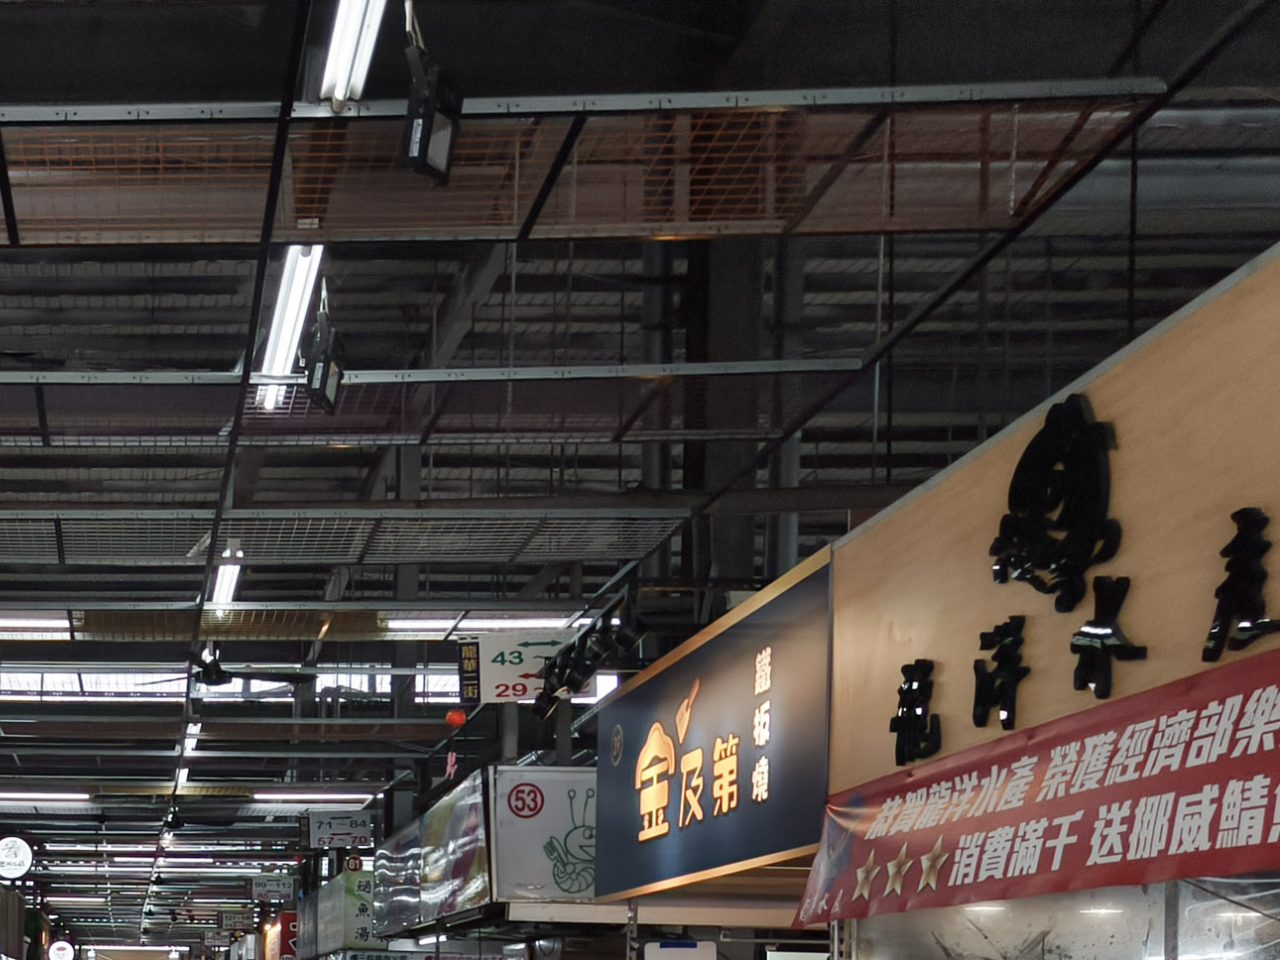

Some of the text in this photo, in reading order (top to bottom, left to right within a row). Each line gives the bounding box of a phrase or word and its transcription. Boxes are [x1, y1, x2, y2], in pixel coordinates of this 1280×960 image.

[514, 788, 539, 812] 53
[634, 722, 740, 842] 金及第
[947, 774, 1280, 887] 消費滿千 送挪威鯖
